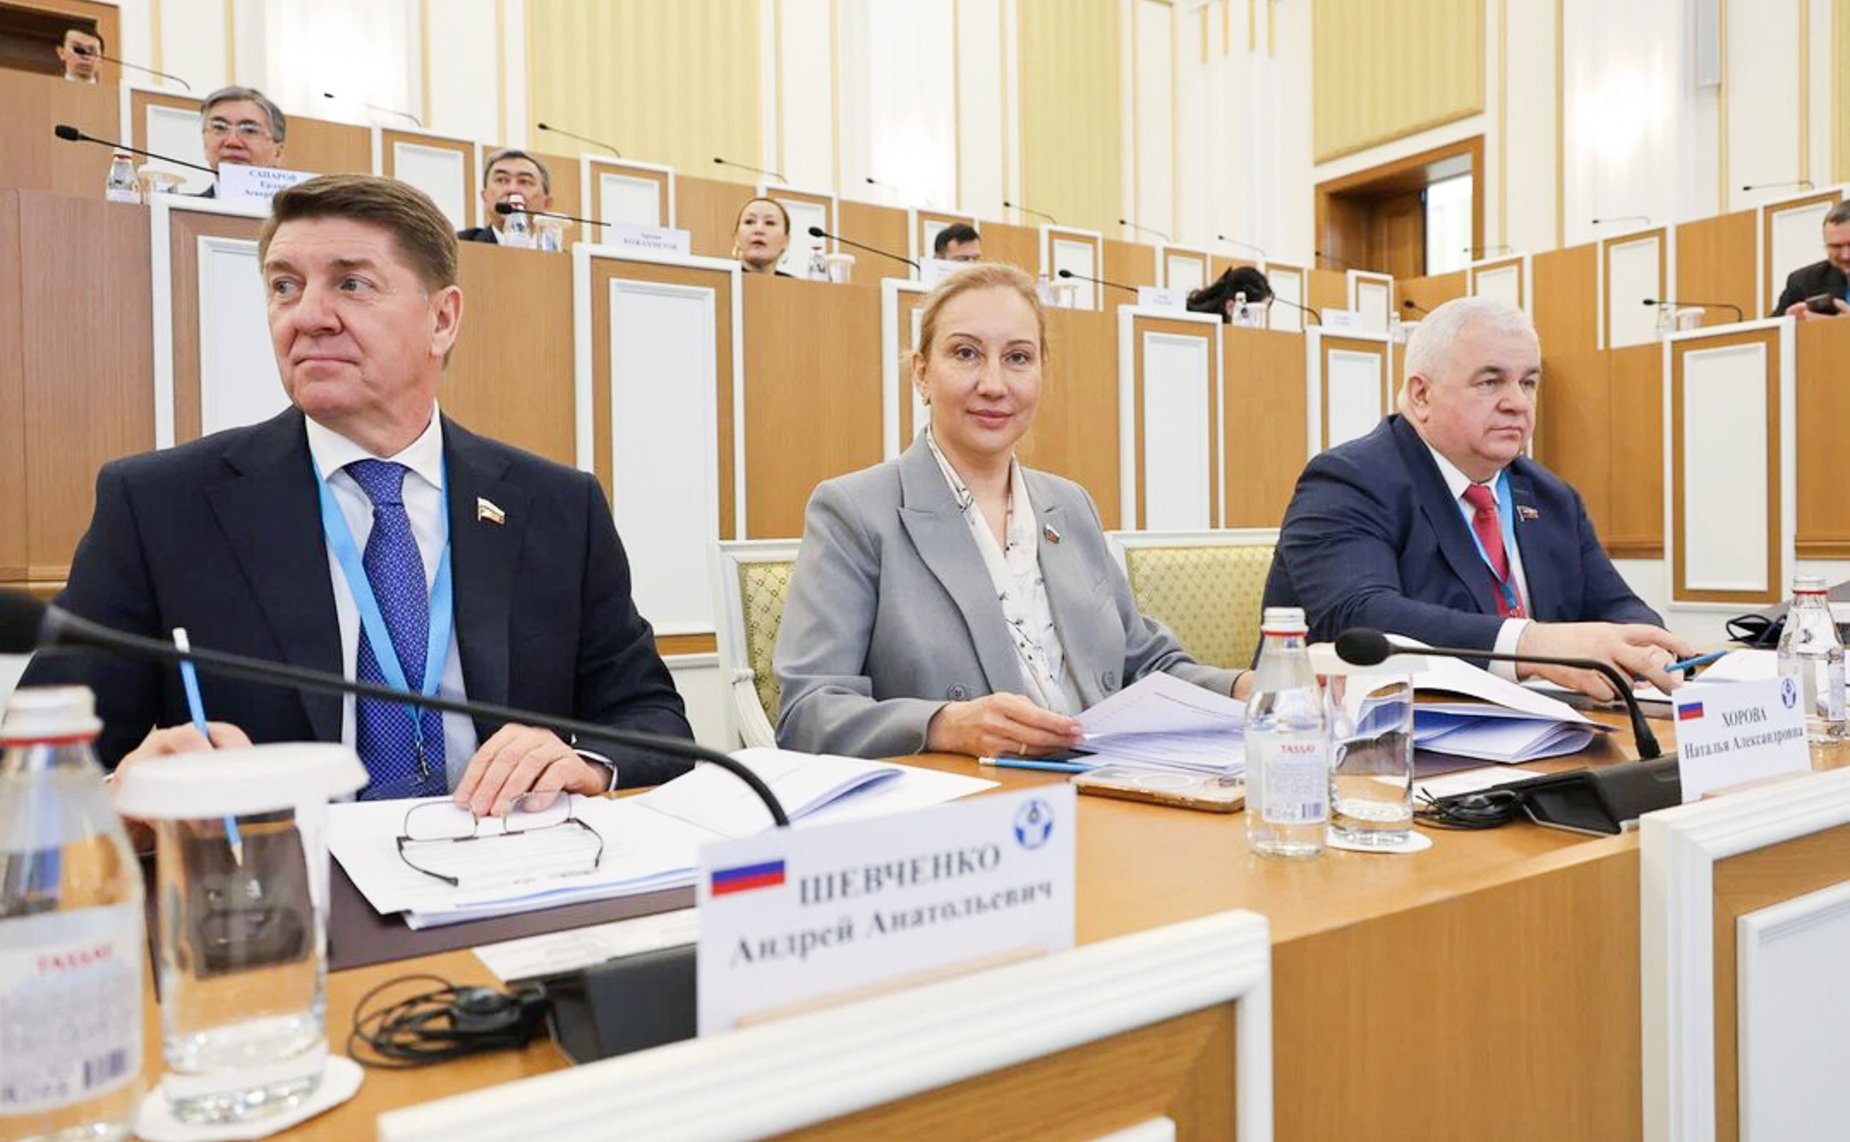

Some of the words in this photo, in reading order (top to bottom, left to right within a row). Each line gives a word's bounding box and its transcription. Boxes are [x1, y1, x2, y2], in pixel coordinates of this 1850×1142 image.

[1721, 706, 1768, 728] ХОРОВА
[1684, 739, 1730, 760] Наталья
[1732, 726, 1804, 751] Александровна
[799, 843, 1001, 905] ШЕВЧЕНКО
[729, 919, 854, 968] Андрей
[864, 879, 1053, 938] Анатольевич
